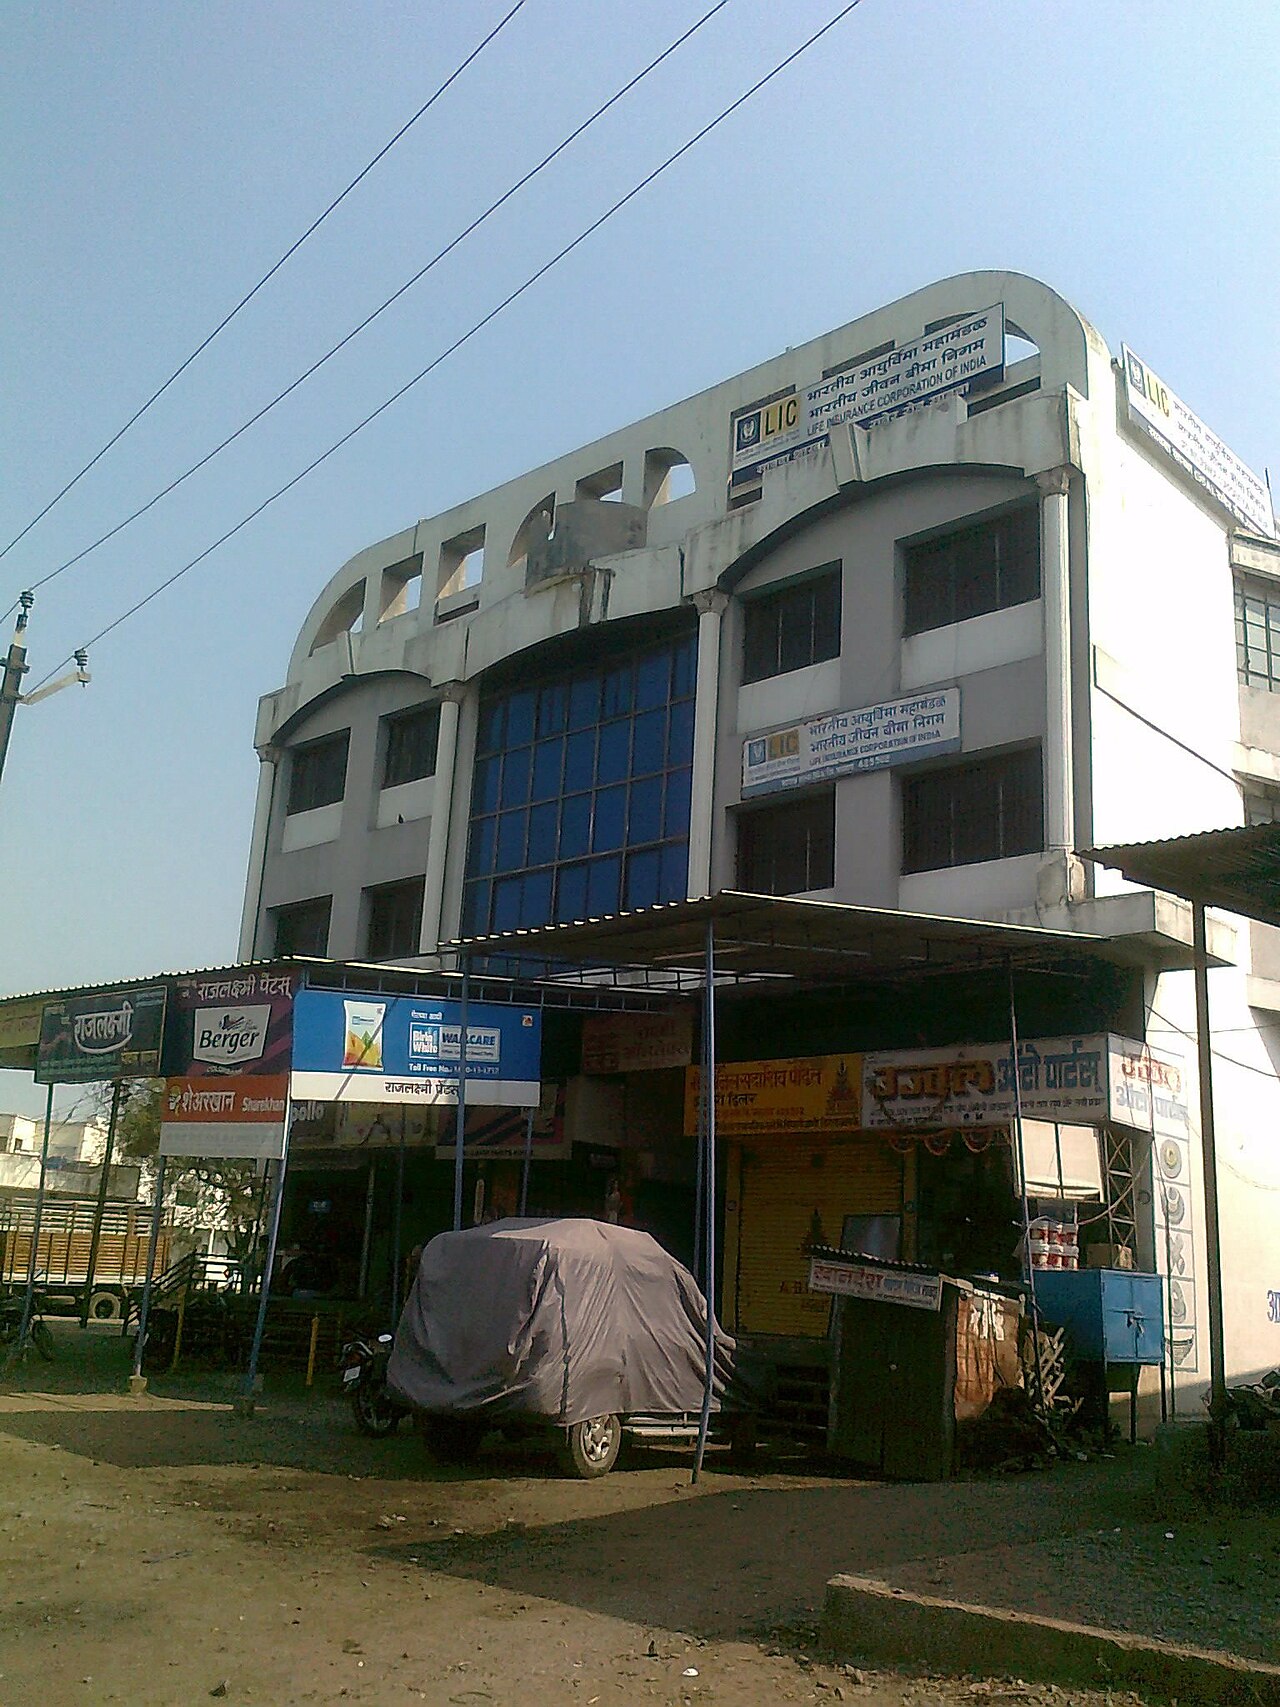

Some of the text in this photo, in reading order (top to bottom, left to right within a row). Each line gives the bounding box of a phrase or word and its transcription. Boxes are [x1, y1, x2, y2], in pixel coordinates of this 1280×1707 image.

[807, 373, 855, 401] भारतीय
[809, 389, 858, 418] भारतीय
[861, 373, 900, 398] जीवन
[941, 337, 985, 365] निगम
[807, 415, 825, 436] LIFE
[877, 371, 943, 408] CORPORATION
[945, 364, 958, 380] OF
[960, 355, 987, 375] INDIA
[1147, 373, 1170, 418] LIC
[765, 399, 797, 436] LIC
[808, 717, 848, 738] भारतीय
[810, 732, 847, 754] भारतीय
[200, 1029, 260, 1055] Berger
[412, 1030, 496, 1046] Birla WACARE
[413, 1041, 438, 1053] White
[409, 1063, 422, 1071] Toll
[422, 1063, 437, 1072] Free
[182, 1083, 236, 1113] शेअरखान
[385, 1079, 432, 1096] राजलक्ष्मी
[290, 1102, 325, 1121] pollo
